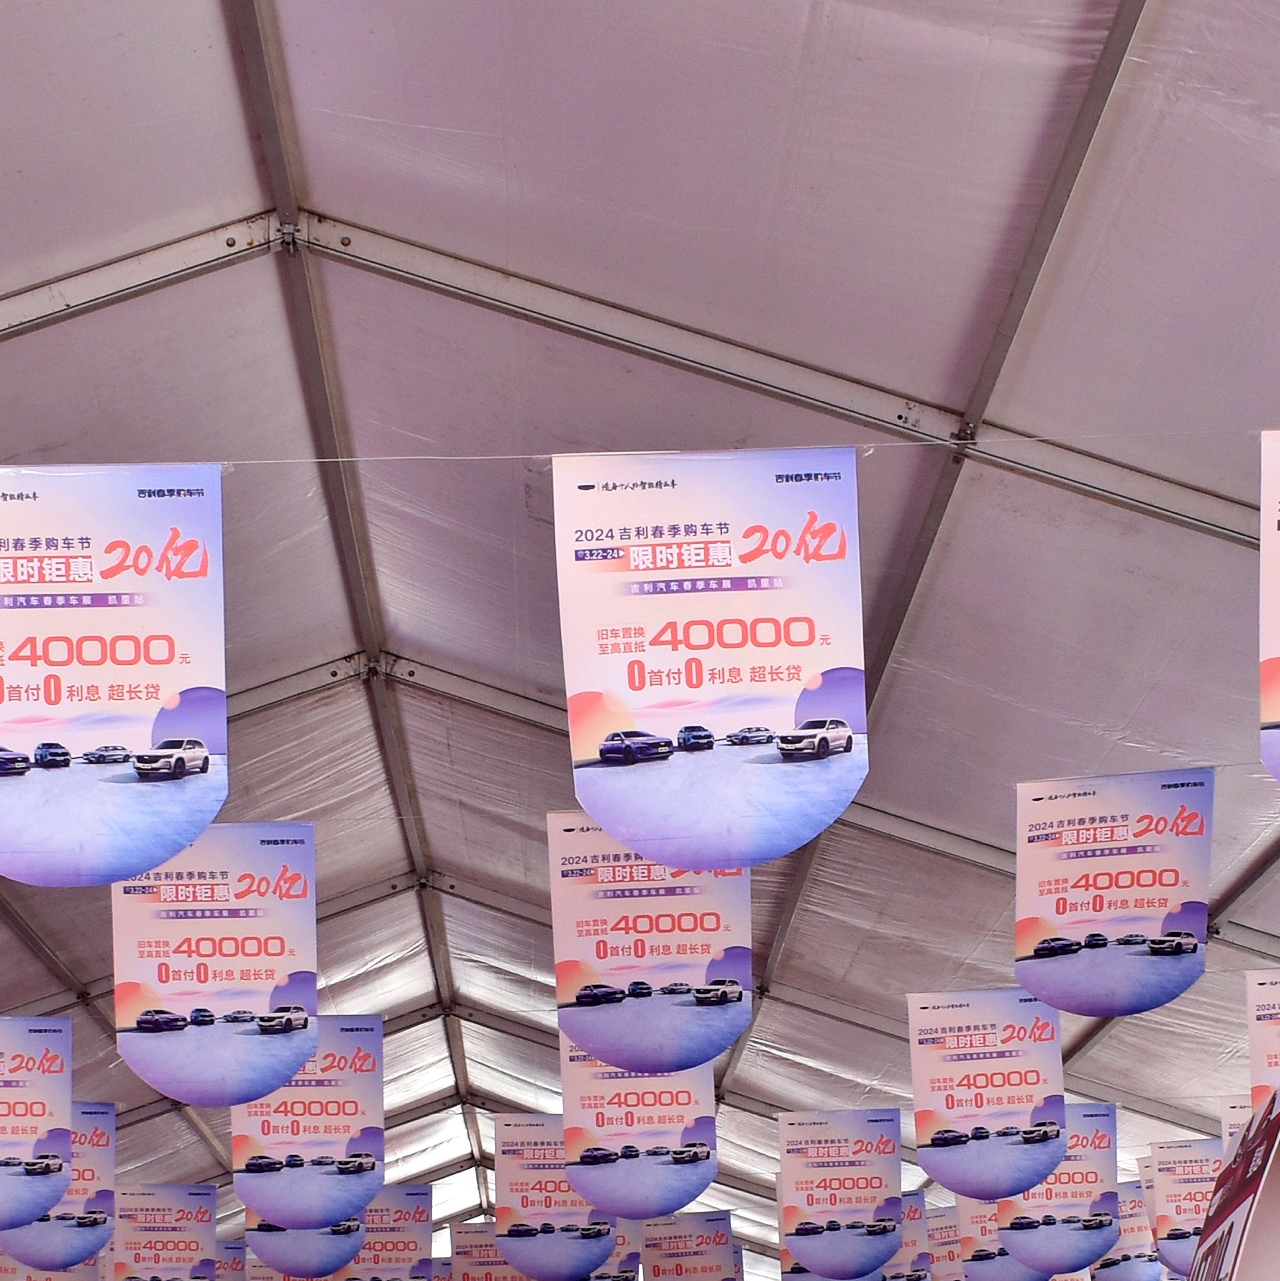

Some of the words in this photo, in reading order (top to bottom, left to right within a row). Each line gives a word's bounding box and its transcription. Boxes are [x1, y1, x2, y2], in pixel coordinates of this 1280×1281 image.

[99, 527, 209, 581] 20亿
[738, 510, 847, 564] 20亿
[629, 542, 733, 570] 限时钜惠
[1132, 806, 1204, 839] 20亿
[234, 864, 308, 901] 20亿
